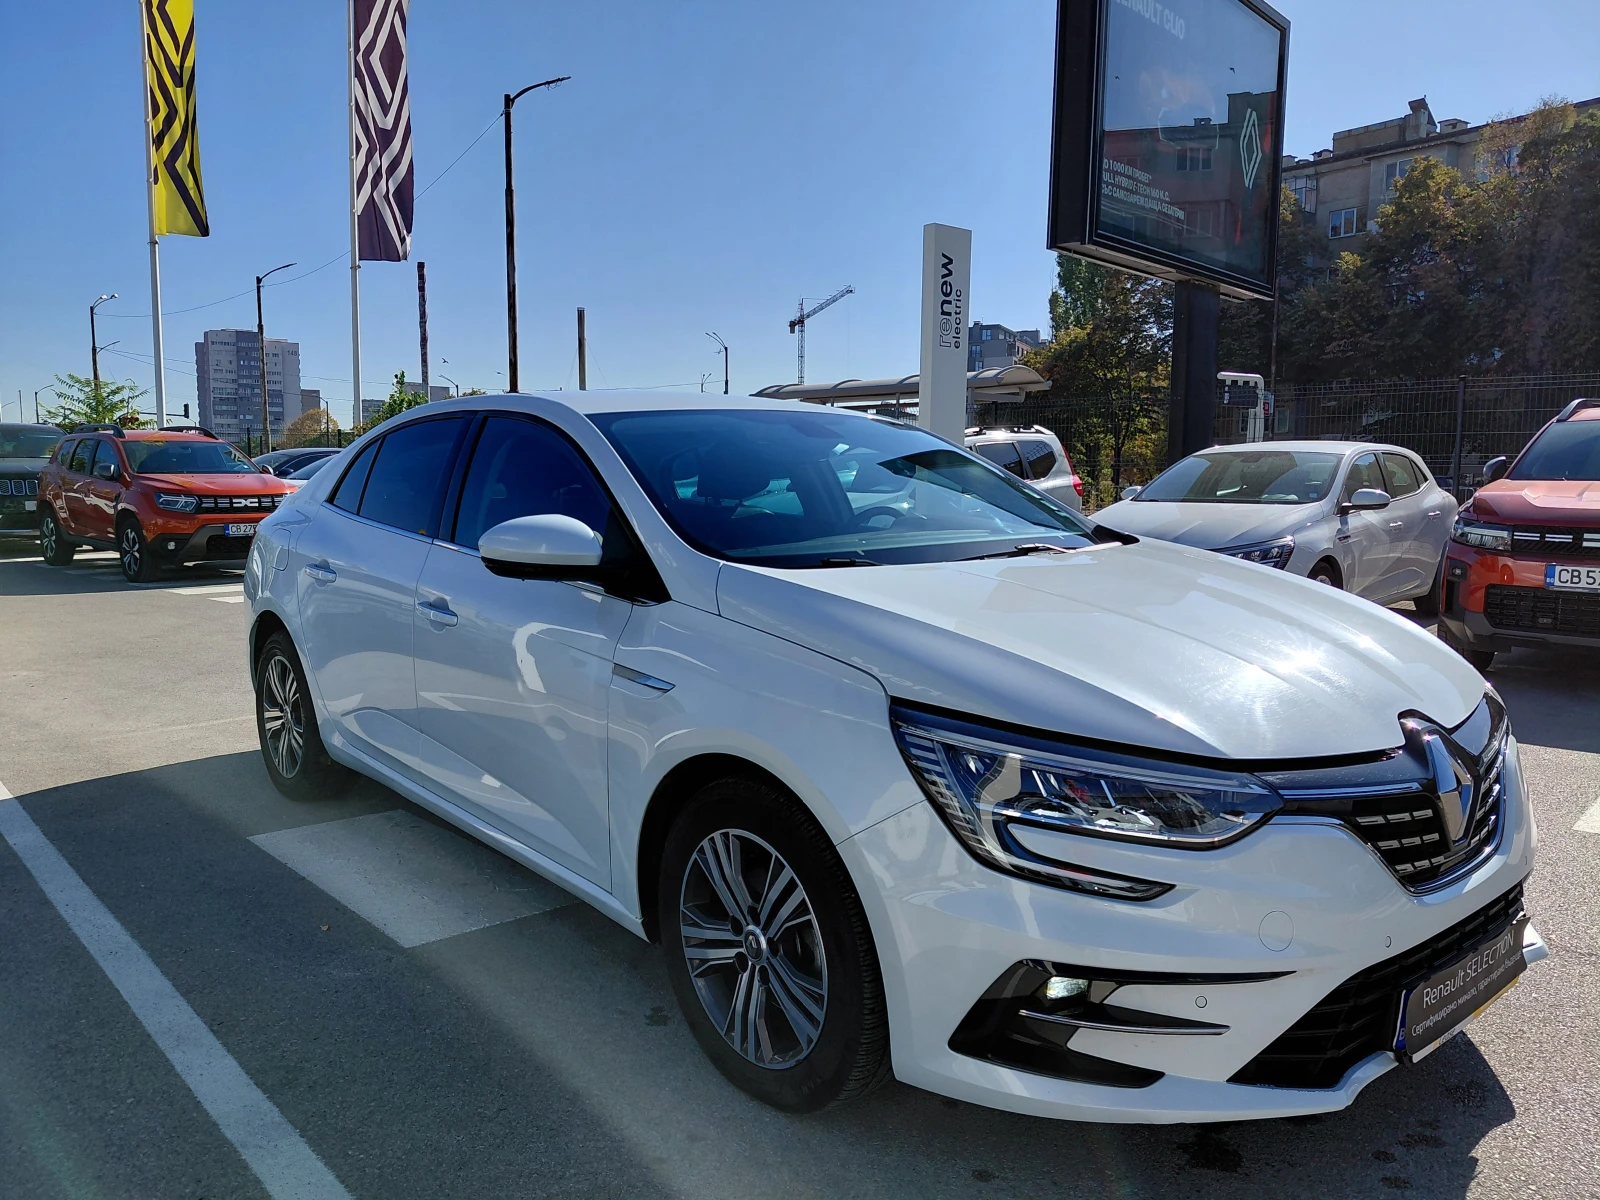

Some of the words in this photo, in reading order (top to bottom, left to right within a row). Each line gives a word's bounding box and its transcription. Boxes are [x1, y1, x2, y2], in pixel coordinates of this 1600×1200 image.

[1163, 9, 1186, 40] CLIO
[1102, 171, 1114, 183] ULL
[1114, 174, 1133, 190] HYBRID
[939, 252, 954, 348] renew
[952, 288, 962, 349] electric
[231, 525, 241, 533] CB
[1558, 568, 1582, 585] CB
[1585, 569, 1600, 586] 5
[1423, 967, 1465, 1009] Renault
[1465, 929, 1515, 982] SELECTION
[1411, 1000, 1458, 1037] Сертифицирано
[1477, 963, 1506, 991] гарантирано
